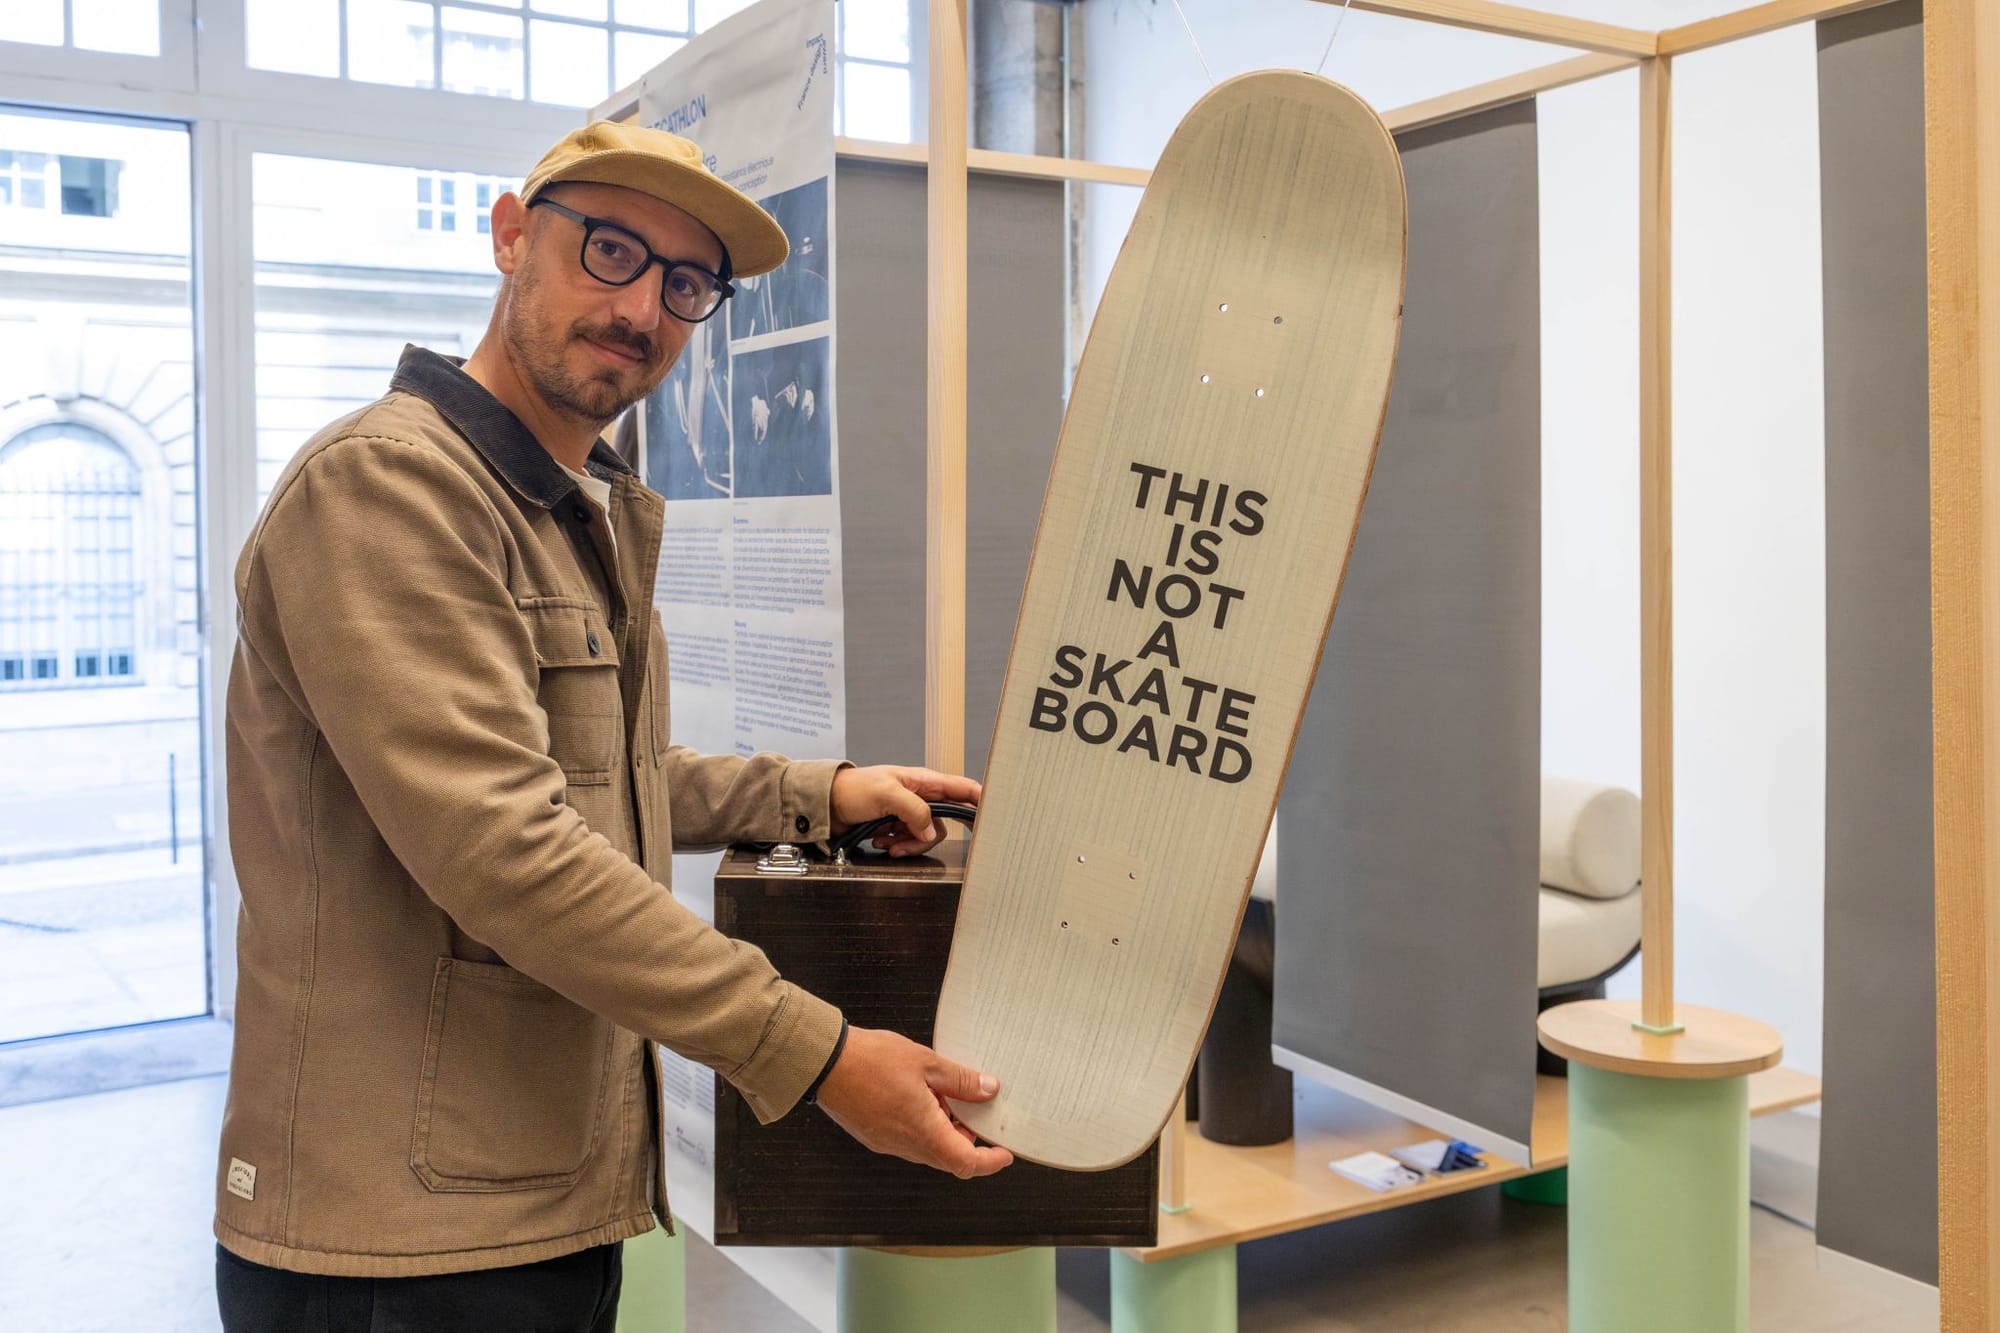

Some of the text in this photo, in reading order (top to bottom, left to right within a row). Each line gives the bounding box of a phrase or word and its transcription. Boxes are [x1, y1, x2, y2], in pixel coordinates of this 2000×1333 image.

[1130, 462, 1268, 536] THIS
[1165, 523, 1223, 575] IS
[1107, 558, 1245, 630] NOT
[1136, 620, 1180, 668] A
[1050, 645, 1256, 738] SKATE
[1029, 687, 1253, 784] BOARD
